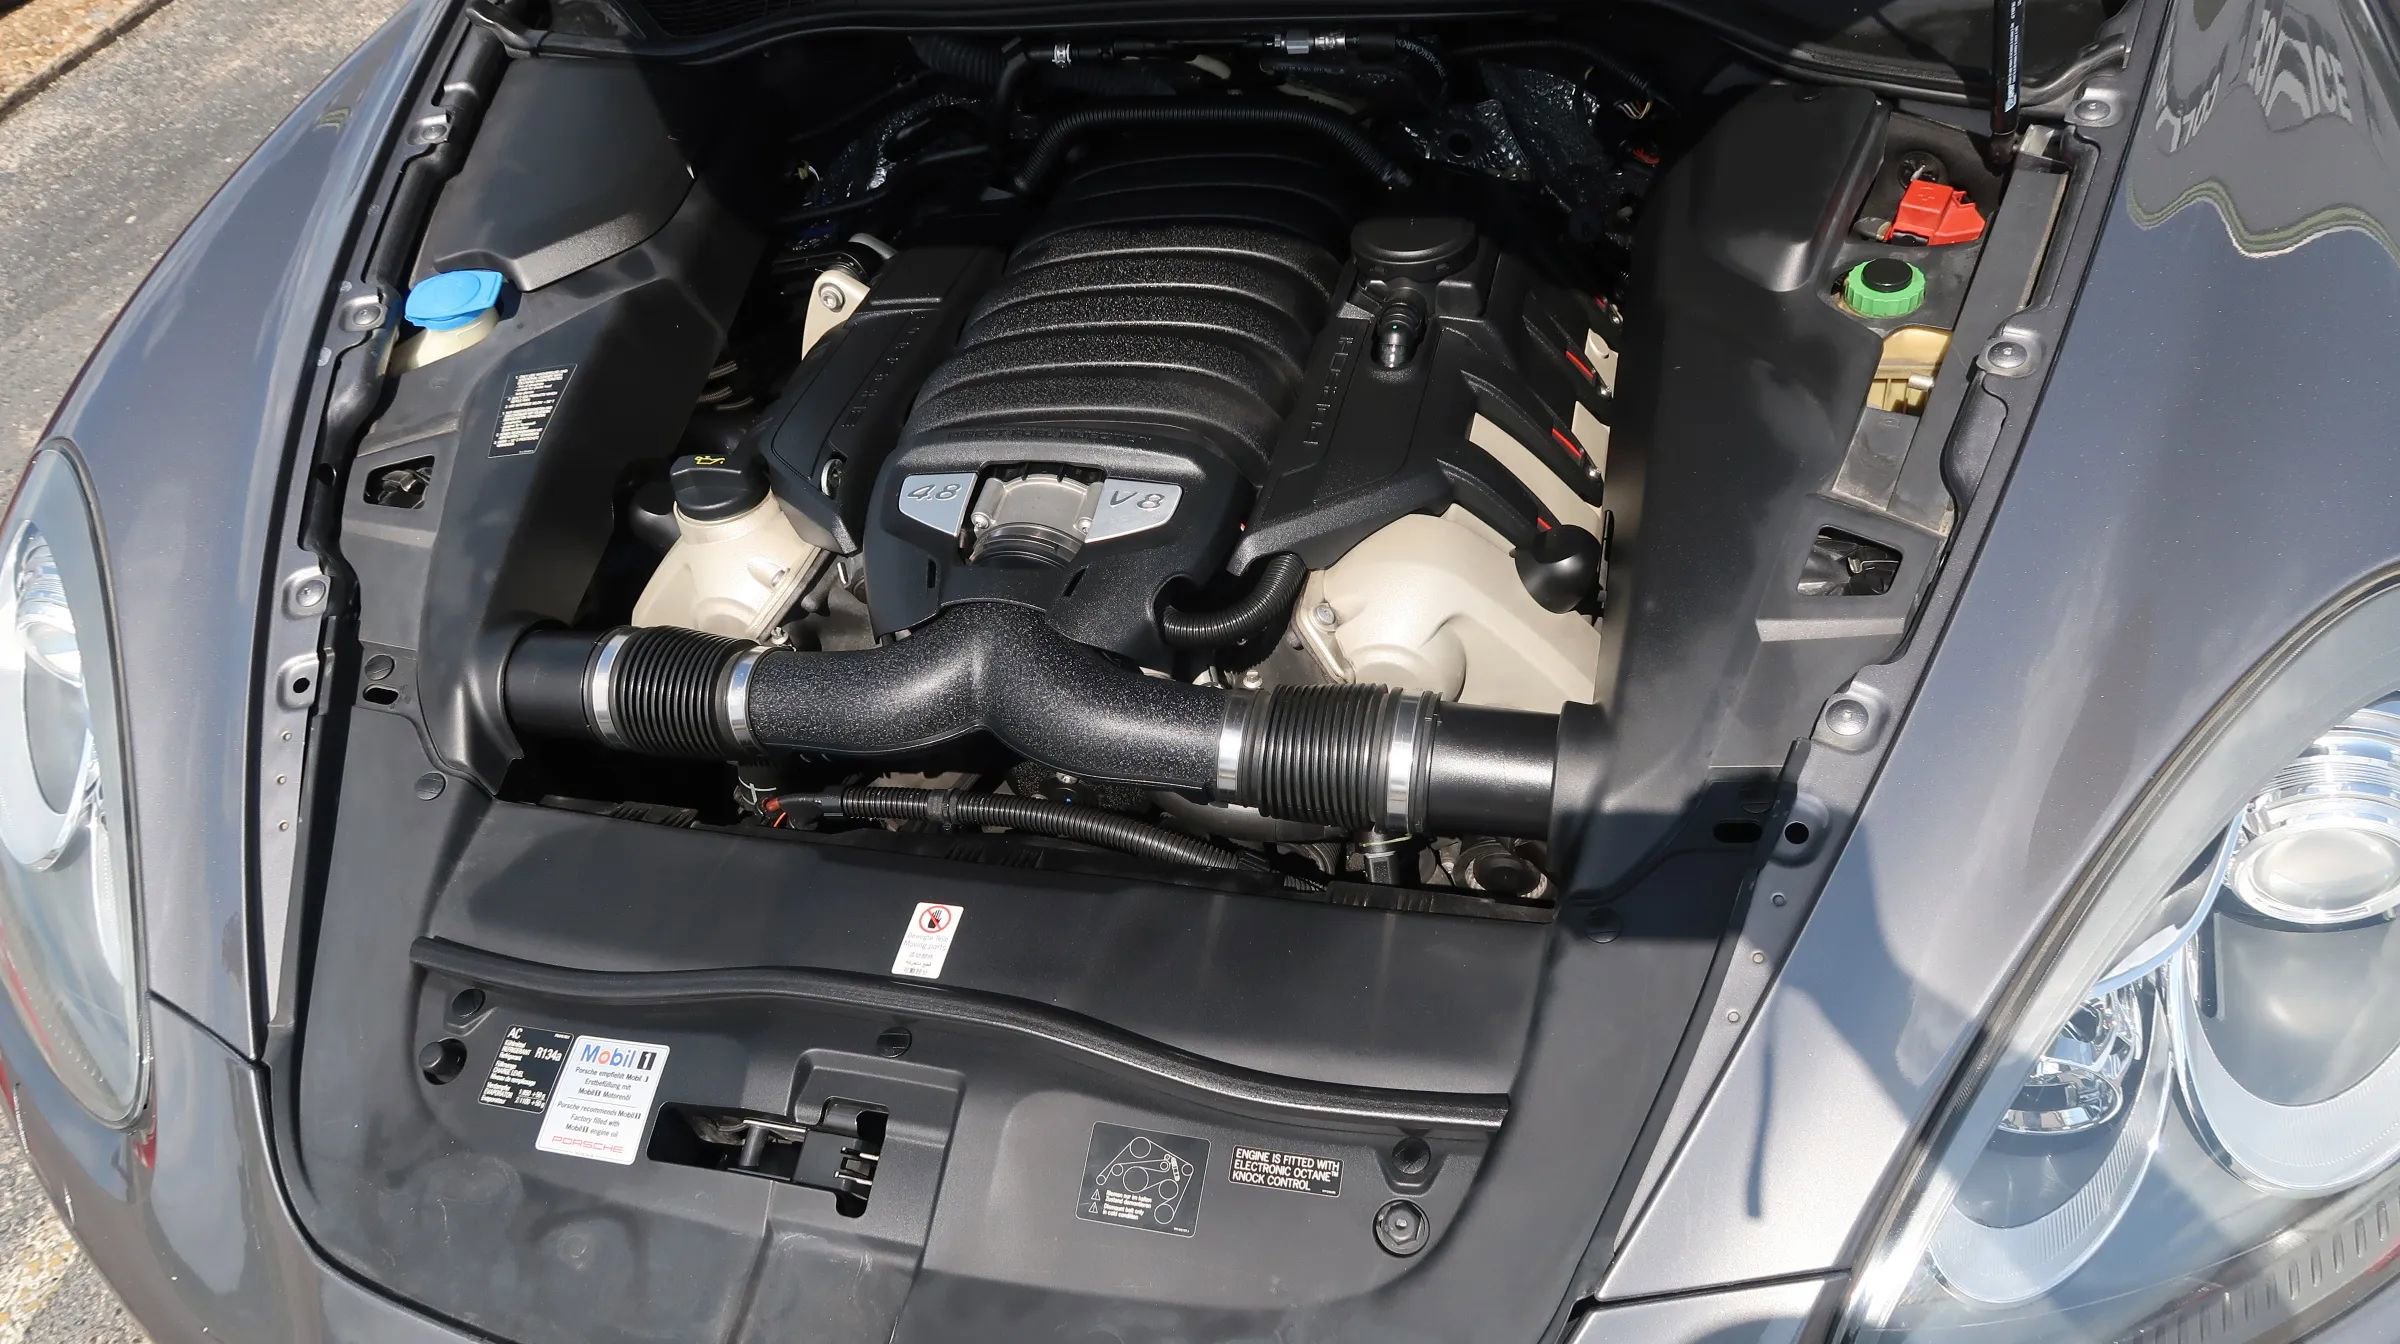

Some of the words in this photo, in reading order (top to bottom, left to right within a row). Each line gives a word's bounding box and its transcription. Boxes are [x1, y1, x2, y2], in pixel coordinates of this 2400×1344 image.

[1109, 489, 1166, 511] V8
[507, 1027, 523, 1039] AC
[534, 1047, 562, 1061] R134a
[581, 1044, 636, 1068] Mobil
[640, 1052, 655, 1070] 1
[575, 1067, 598, 1076] Porsche
[626, 1073, 641, 1081] Mobil
[557, 1101, 580, 1110] Porsche
[582, 1105, 617, 1114] recommends
[570, 1114, 592, 1124] Factory
[593, 1116, 607, 1125] filled
[608, 1119, 620, 1127] with
[590, 1128, 609, 1137] engine
[552, 1135, 625, 1153] PORSCHE
[1236, 1148, 1270, 1162] ENGINE
[1272, 1154, 1281, 1164] IS
[1283, 1155, 1314, 1168] FITTED
[1316, 1159, 1340, 1171] WITH
[1234, 1160, 1291, 1176] ELECTRONIC
[1232, 1170, 1265, 1184] KNOCK
[1267, 1175, 1311, 1191] CONTROL
